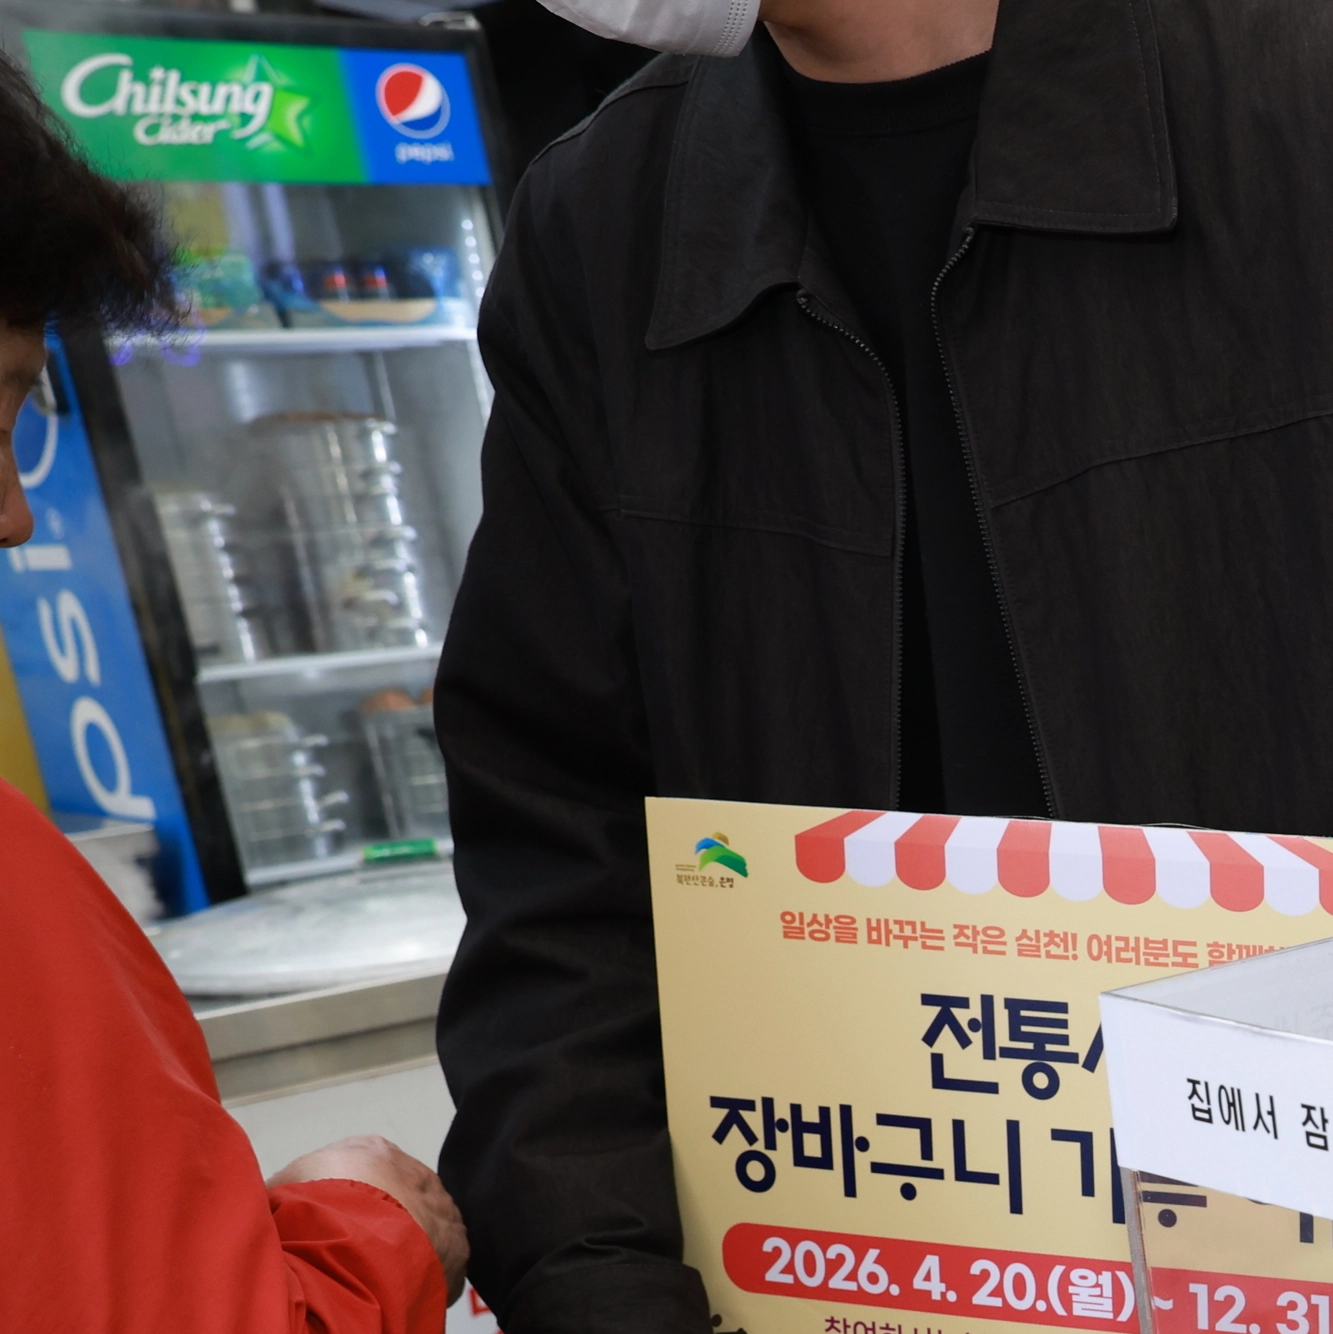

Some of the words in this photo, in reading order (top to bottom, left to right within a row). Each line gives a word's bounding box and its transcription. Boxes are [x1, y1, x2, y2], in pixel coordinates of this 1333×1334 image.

[61, 53, 273, 139] Chilsung
[134, 116, 231, 146] Cider
[395, 142, 455, 164] pepsi
[780, 911, 858, 944] 일상을
[866, 918, 945, 951] 바꾸는
[952, 923, 1007, 956] 작은
[1015, 928, 1079, 961] 실천!
[1086, 933, 1199, 969] 여러분도
[920, 993, 1104, 1100] 전통
[1186, 1077, 1279, 1140] 집에서
[709, 1095, 1024, 1215] 장바구니
[762, 1236, 900, 1296] 2026.
[912, 1254, 957, 1302] 4.
[969, 1259, 1135, 1323] 20.(월)
